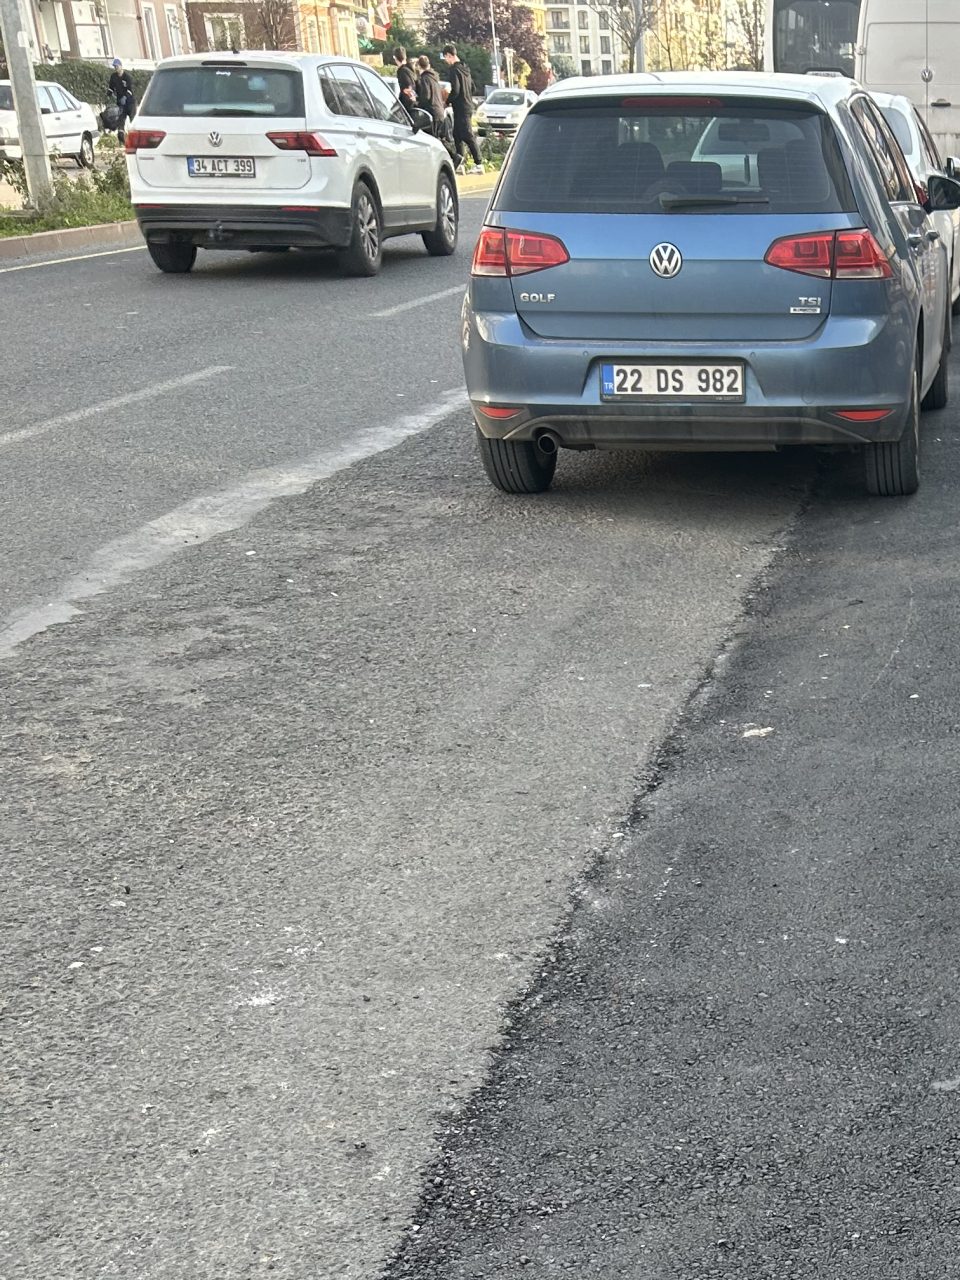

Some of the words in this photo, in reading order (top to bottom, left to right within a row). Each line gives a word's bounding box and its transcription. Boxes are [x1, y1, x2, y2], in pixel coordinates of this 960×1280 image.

[195, 159, 207, 172] 34
[211, 159, 228, 172] ACT
[234, 159, 252, 172] 399
[520, 292, 556, 303] GOLF
[798, 296, 821, 306] TSI
[604, 382, 614, 390] TR
[615, 368, 643, 393] 22
[656, 368, 684, 393] DS
[697, 368, 739, 393] 982
